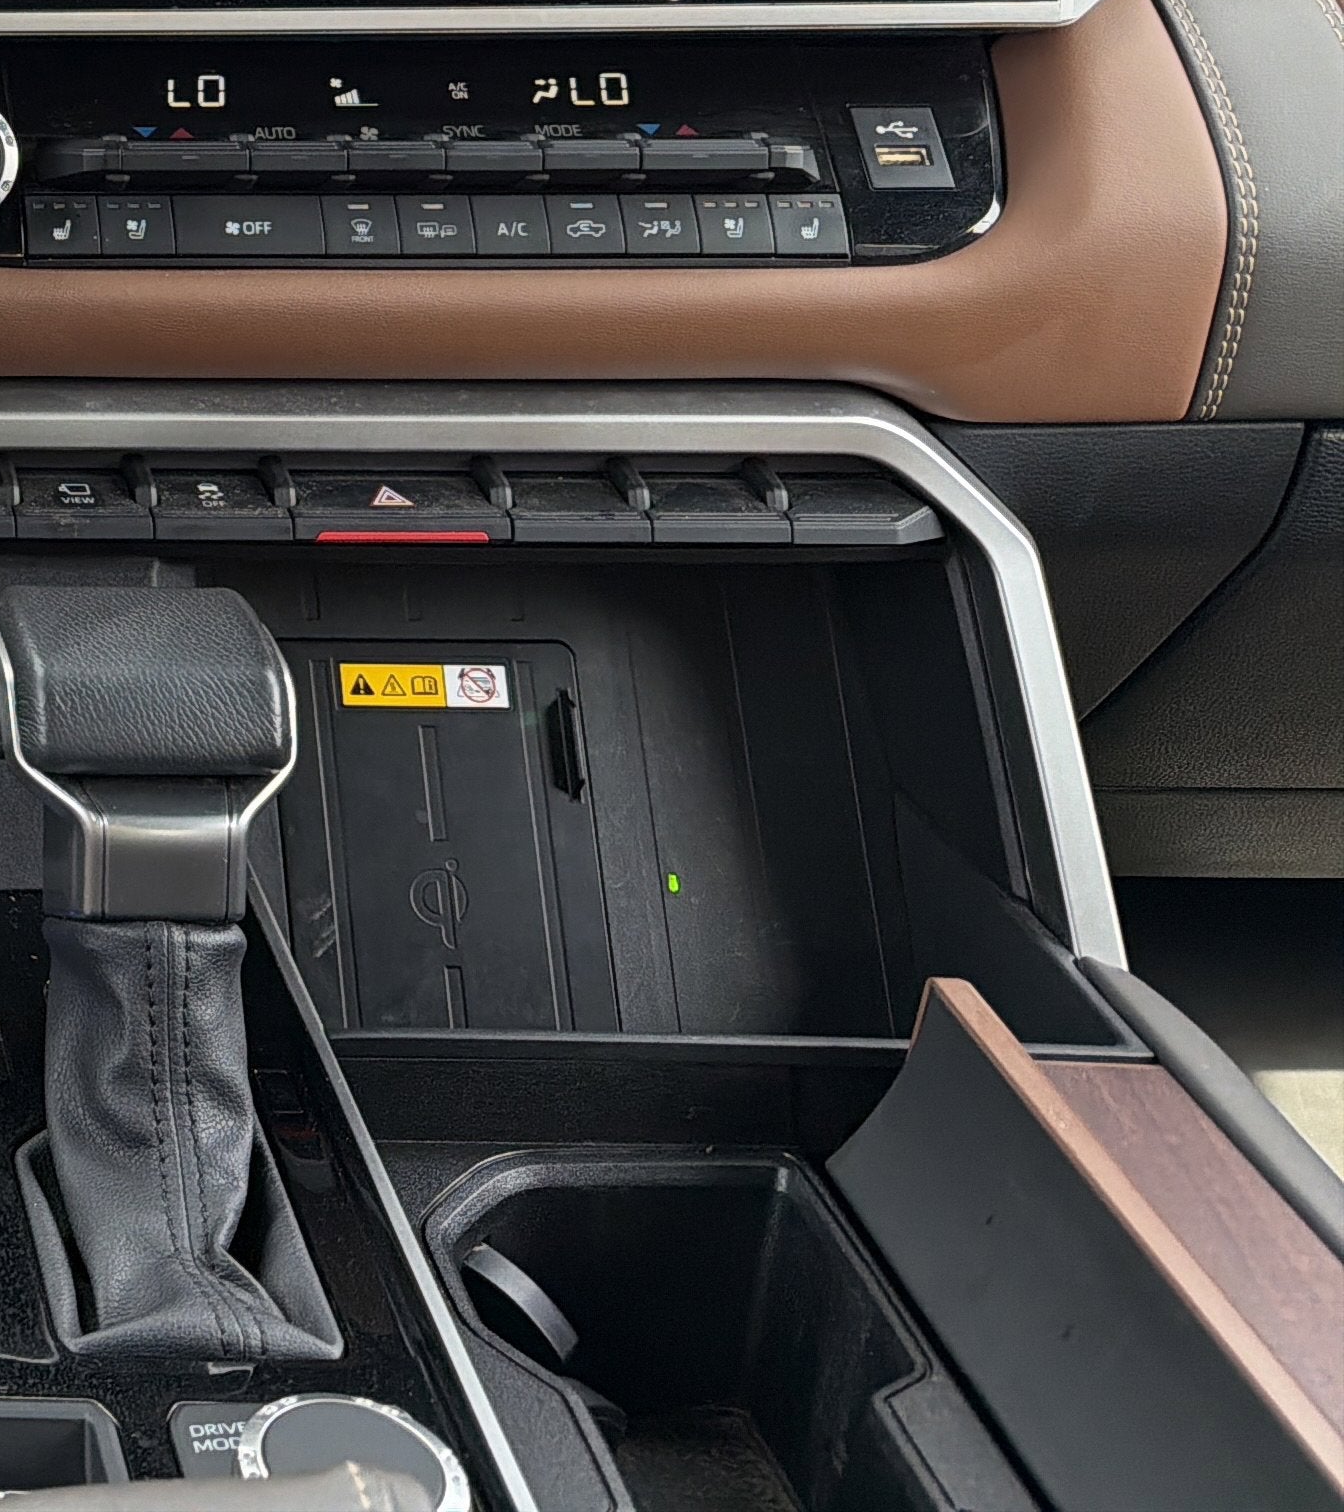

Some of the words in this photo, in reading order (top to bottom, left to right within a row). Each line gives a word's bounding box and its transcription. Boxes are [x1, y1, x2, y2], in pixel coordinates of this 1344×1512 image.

[167, 75, 225, 108] LO
[448, 81, 468, 92] A/C
[569, 72, 630, 106] LO
[451, 91, 469, 100] ON
[254, 126, 296, 140] AUTO
[442, 124, 486, 138] SYNC
[534, 124, 583, 138] MODE
[242, 221, 273, 236] OFF
[497, 221, 528, 237] A/C
[351, 235, 374, 244] FRONT
[60, 495, 95, 505] VIEW
[192, 1436, 242, 1454] MOD
